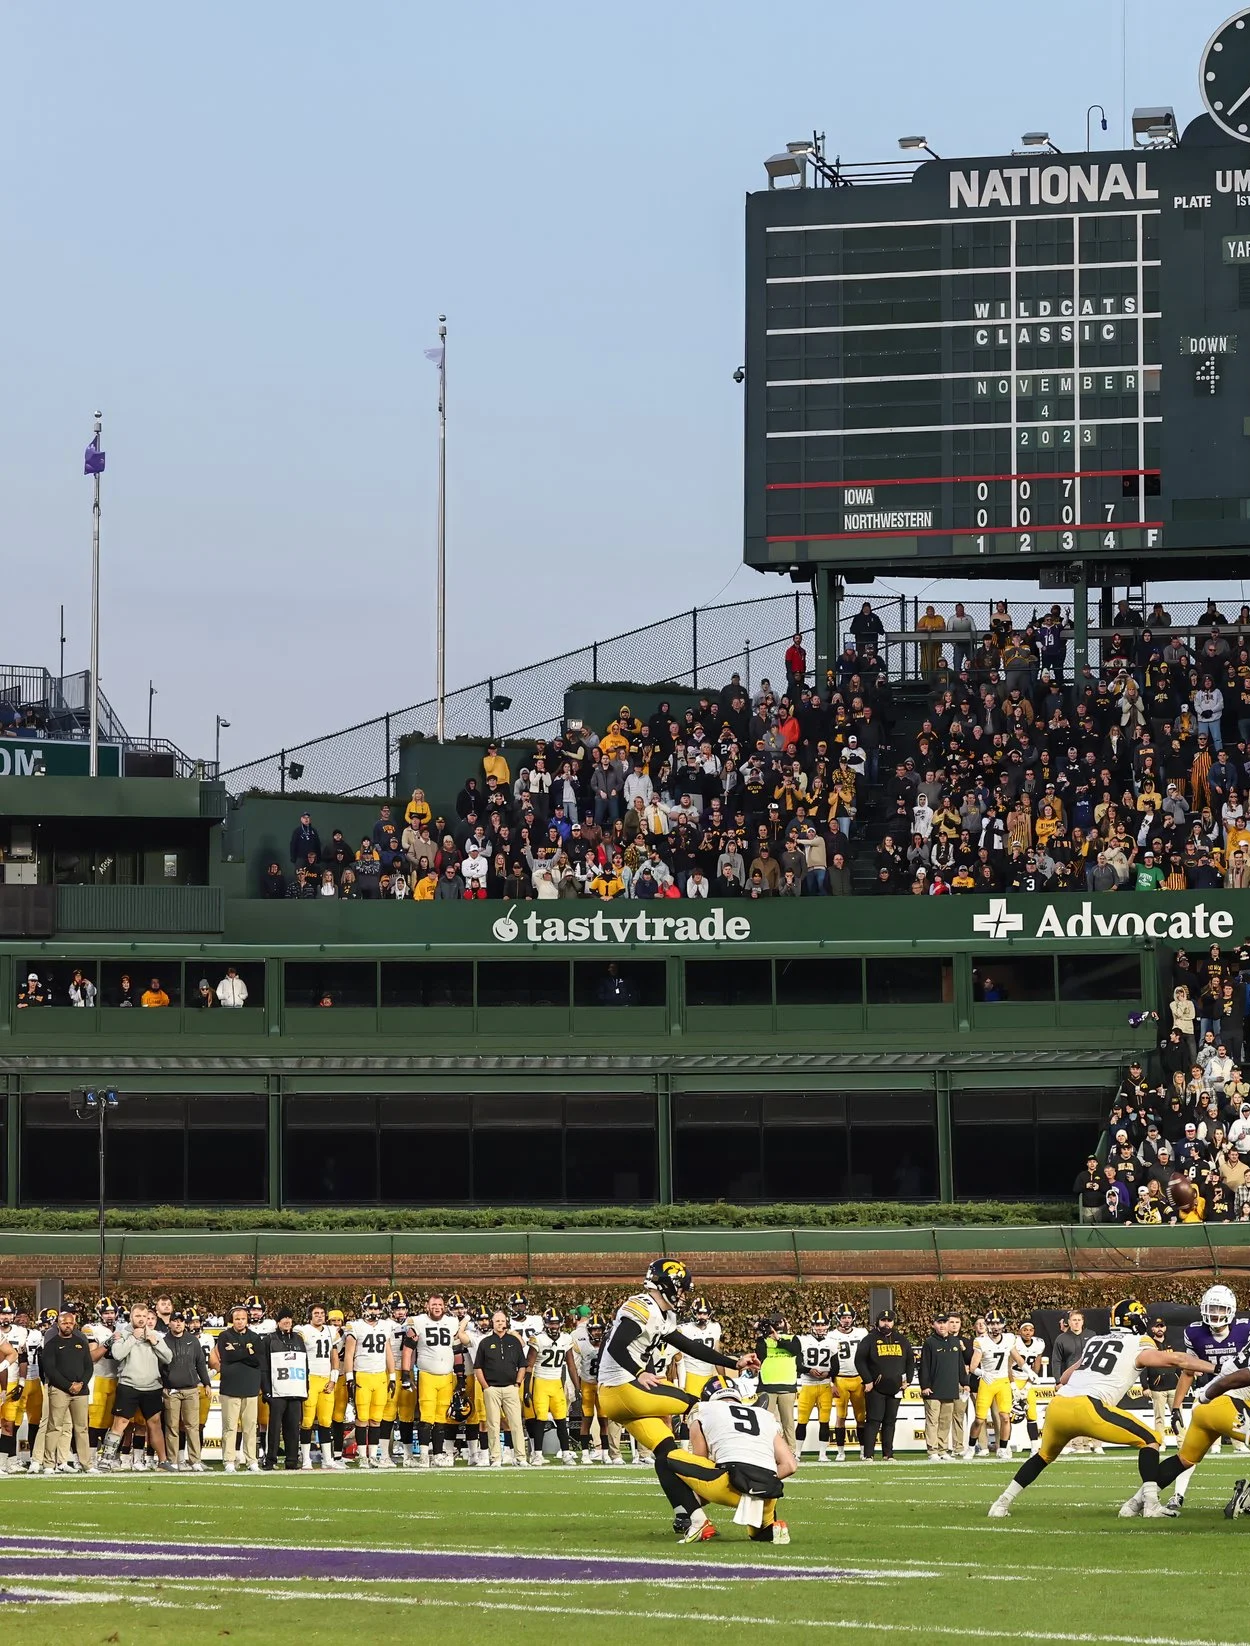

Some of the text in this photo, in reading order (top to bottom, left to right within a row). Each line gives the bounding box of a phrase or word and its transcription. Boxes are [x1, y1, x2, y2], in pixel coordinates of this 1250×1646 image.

[949, 162, 1159, 209] NATIONAL
[1174, 195, 1212, 209] PLATE
[974, 297, 1136, 318] WILDCATS
[976, 324, 1115, 345] CLASSIC
[1190, 337, 1227, 353] DOWN
[977, 374, 1136, 395] NOVEMBER
[1195, 356, 1220, 394] 4
[1041, 405, 1049, 418] 4
[1021, 429, 1092, 445] 2023
[844, 479, 1072, 505] IOWA 0 0 7
[844, 504, 1115, 530] NORTHWESTERN 0 0 0 7
[976, 529, 1158, 553] 1 2 3 4 F
[1026, 878, 1036, 891] 3
[523, 907, 751, 943] tastytrade
[1035, 901, 1234, 939] Advocate
[362, 1333, 386, 1354] 48
[425, 1327, 451, 1347] 56
[315, 1339, 330, 1359] 11
[541, 1349, 564, 1368] 20
[806, 1347, 831, 1367] 92
[839, 1340, 860, 1359] 97
[876, 1344, 903, 1353] IOWA
[1076, 1340, 1124, 1375] 86
[993, 1352, 1005, 1371] 7
[729, 1405, 760, 1437] 9
[202, 1438, 222, 1448] WALT
